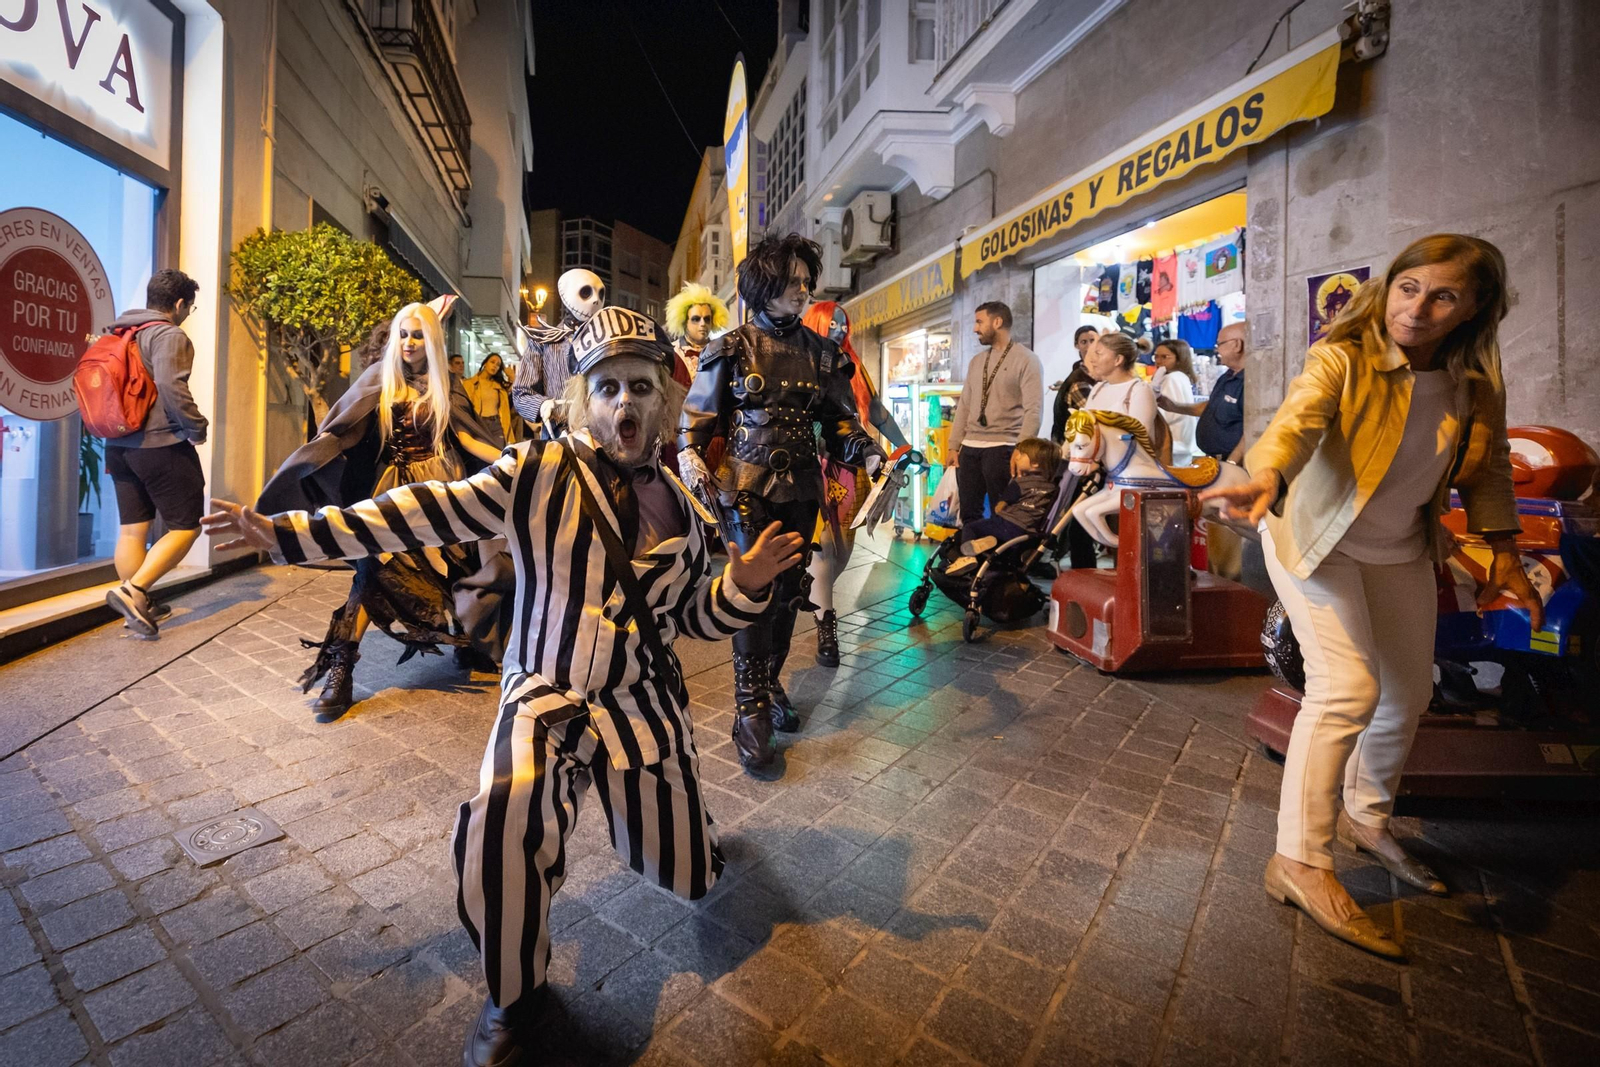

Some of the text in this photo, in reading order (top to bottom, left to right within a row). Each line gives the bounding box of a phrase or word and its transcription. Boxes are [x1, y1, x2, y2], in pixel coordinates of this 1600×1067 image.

[980, 92, 1264, 261] GOLOSINAS Y REGALOS
[40, 221, 61, 242] EN
[66, 234, 106, 300] VENTAS
[14, 269, 78, 303] GRACIAS
[13, 300, 77, 333] POR TU
[581, 308, 648, 351] GUIDE
[12, 335, 75, 358] CONFIANZA
